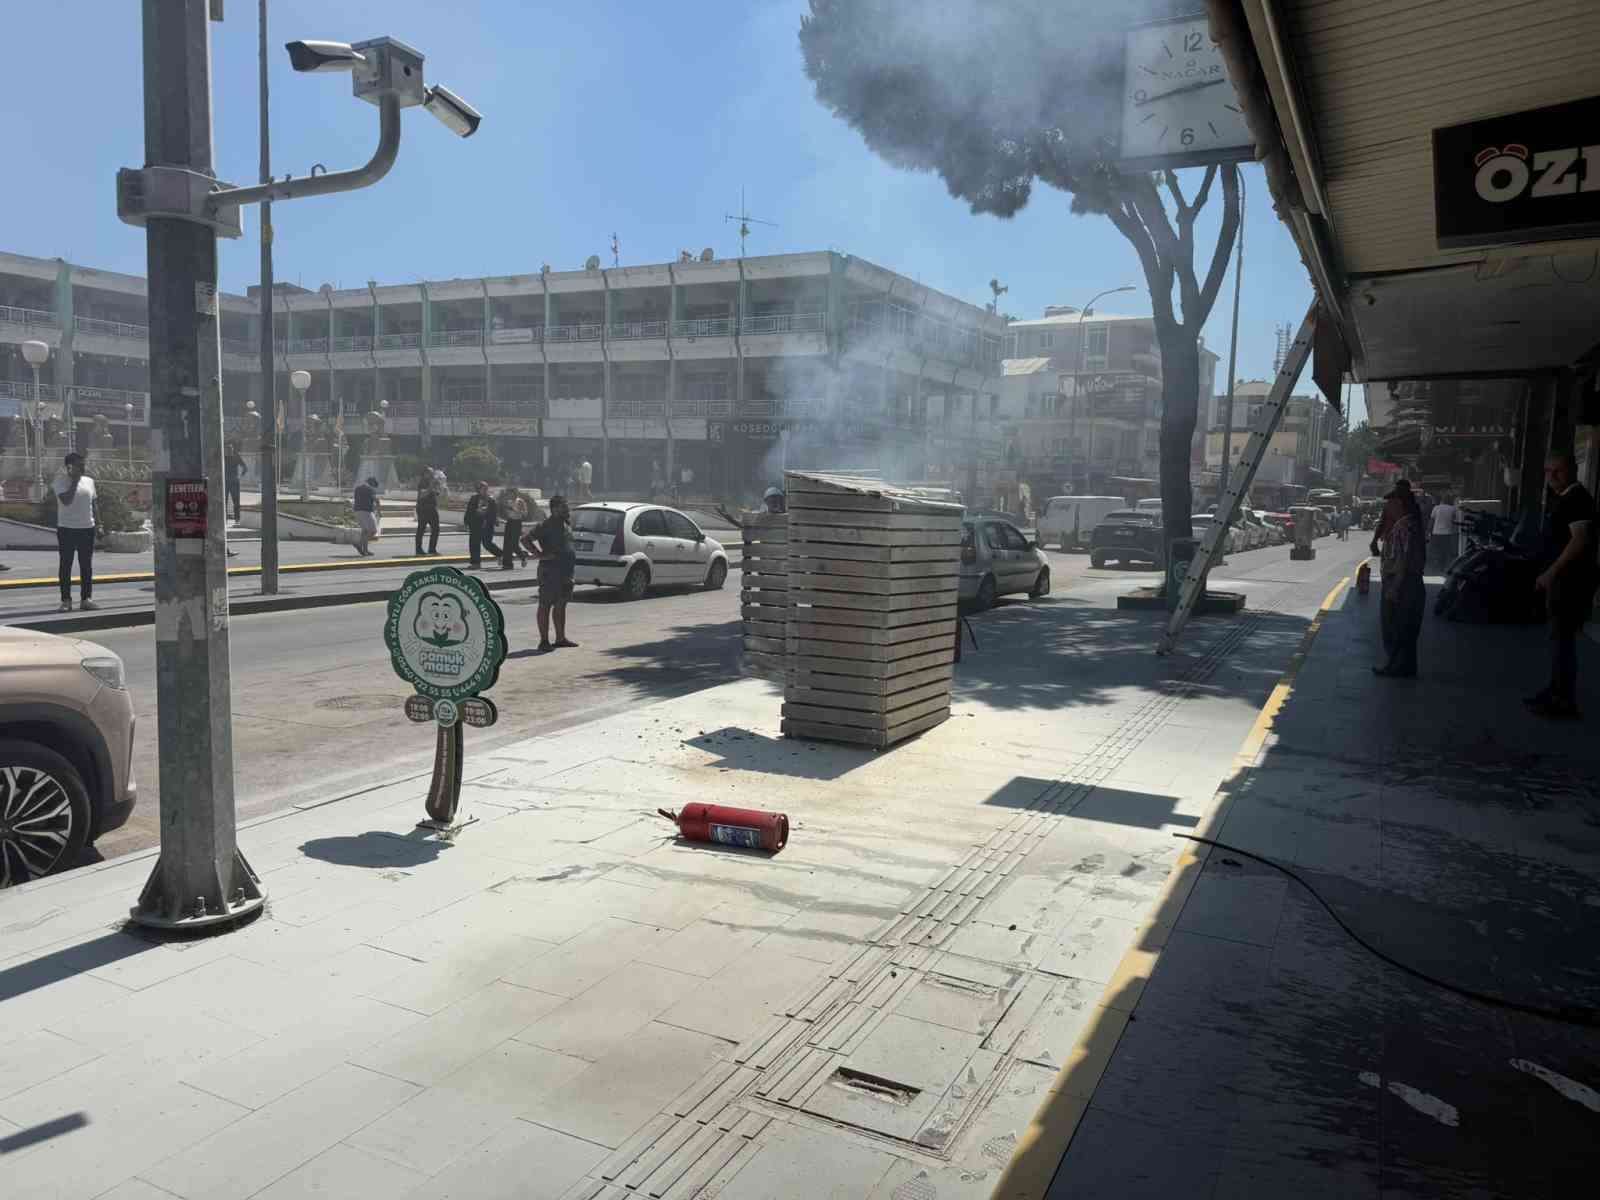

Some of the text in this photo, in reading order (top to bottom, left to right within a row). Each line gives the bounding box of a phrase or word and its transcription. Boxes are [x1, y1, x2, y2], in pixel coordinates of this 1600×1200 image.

[1184, 32, 1202, 52] 12
[1181, 128, 1195, 145] 6
[420, 652, 464, 665] pamuk
